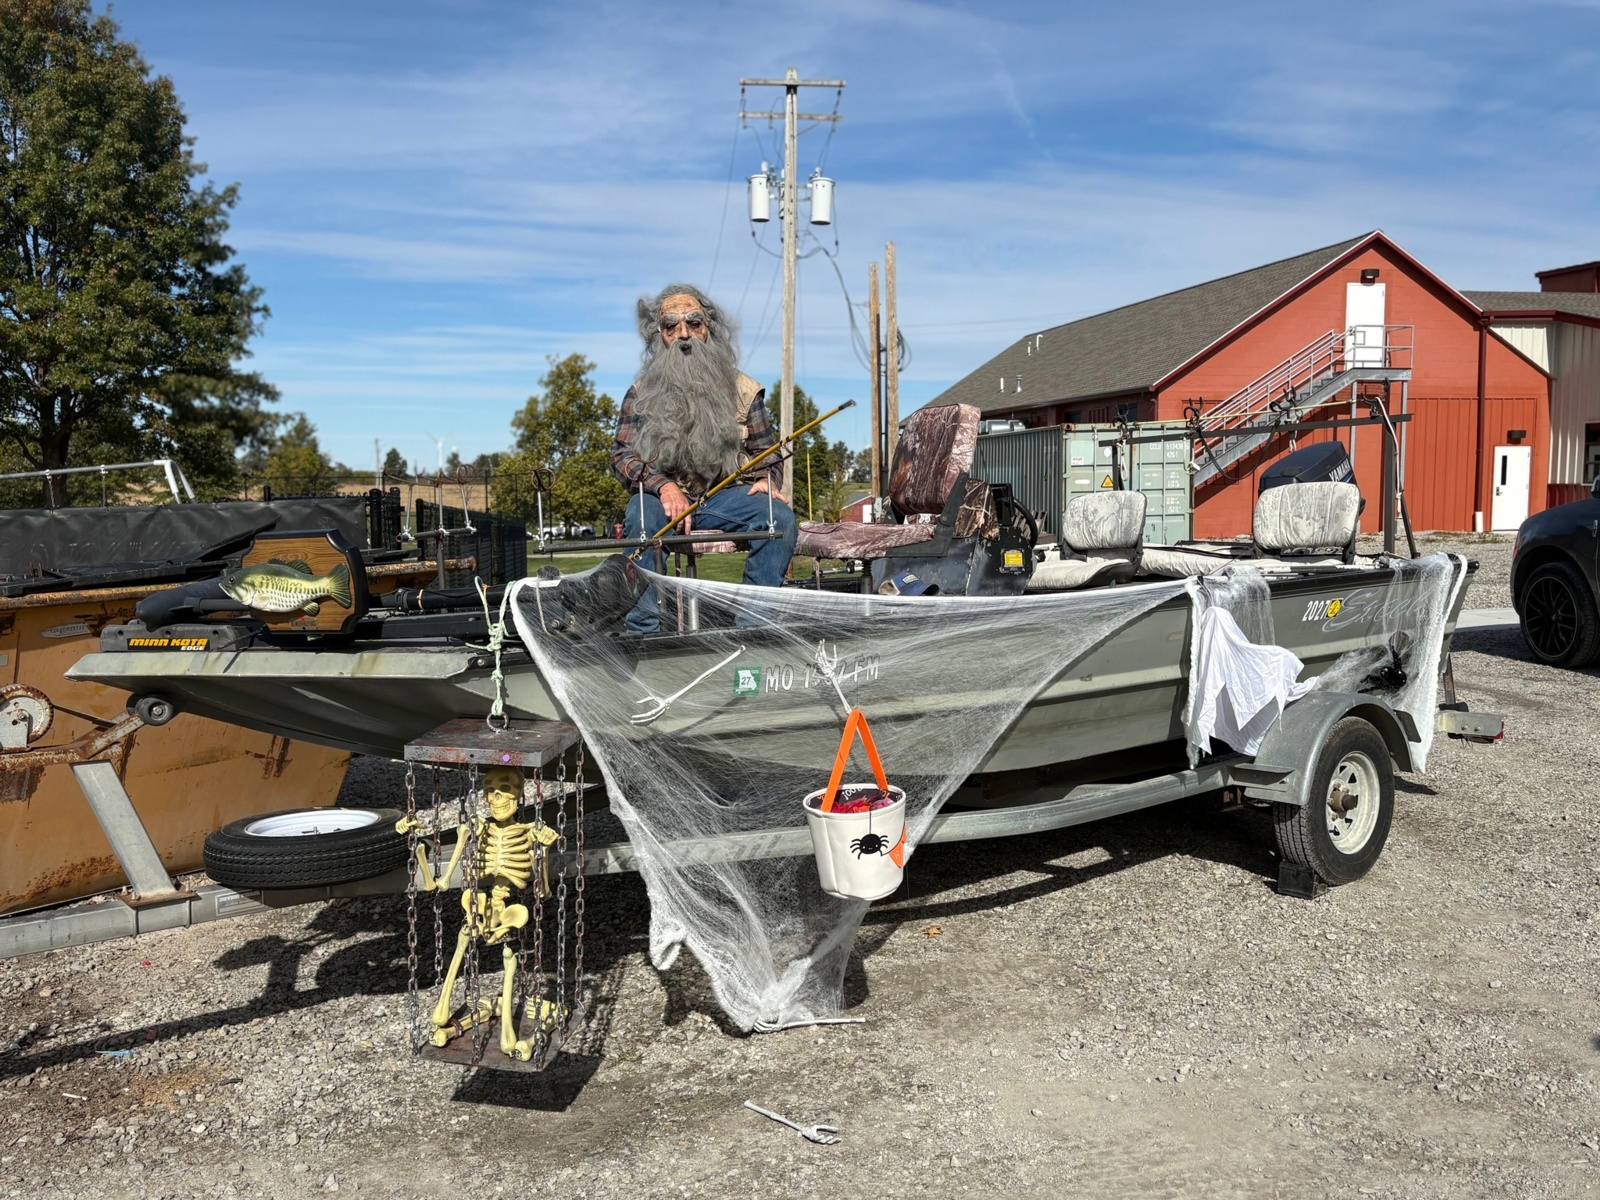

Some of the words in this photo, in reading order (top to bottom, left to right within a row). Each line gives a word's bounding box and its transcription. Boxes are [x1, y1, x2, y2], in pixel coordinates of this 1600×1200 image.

[1302, 599, 1330, 622] 2027
[129, 638, 169, 647] MINN
[170, 638, 209, 647] KOTA
[741, 676, 752, 686] 27
[765, 664, 795, 693] MO
[853, 653, 881, 682] FM
